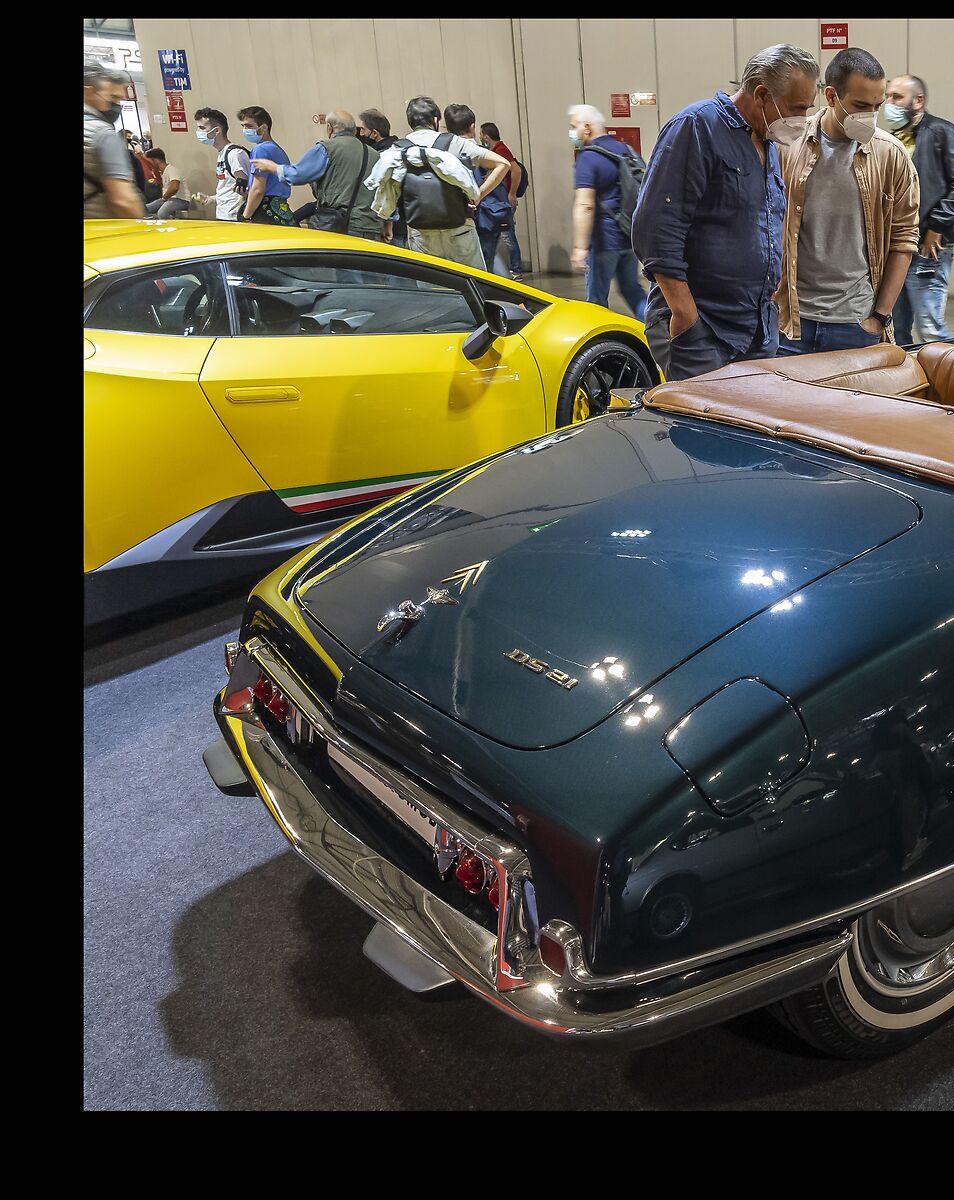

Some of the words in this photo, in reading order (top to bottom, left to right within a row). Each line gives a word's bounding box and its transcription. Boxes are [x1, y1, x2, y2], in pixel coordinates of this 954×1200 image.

[173, 77, 187, 86] TIM
[502, 648, 550, 674] DS
[545, 668, 579, 690] 21
